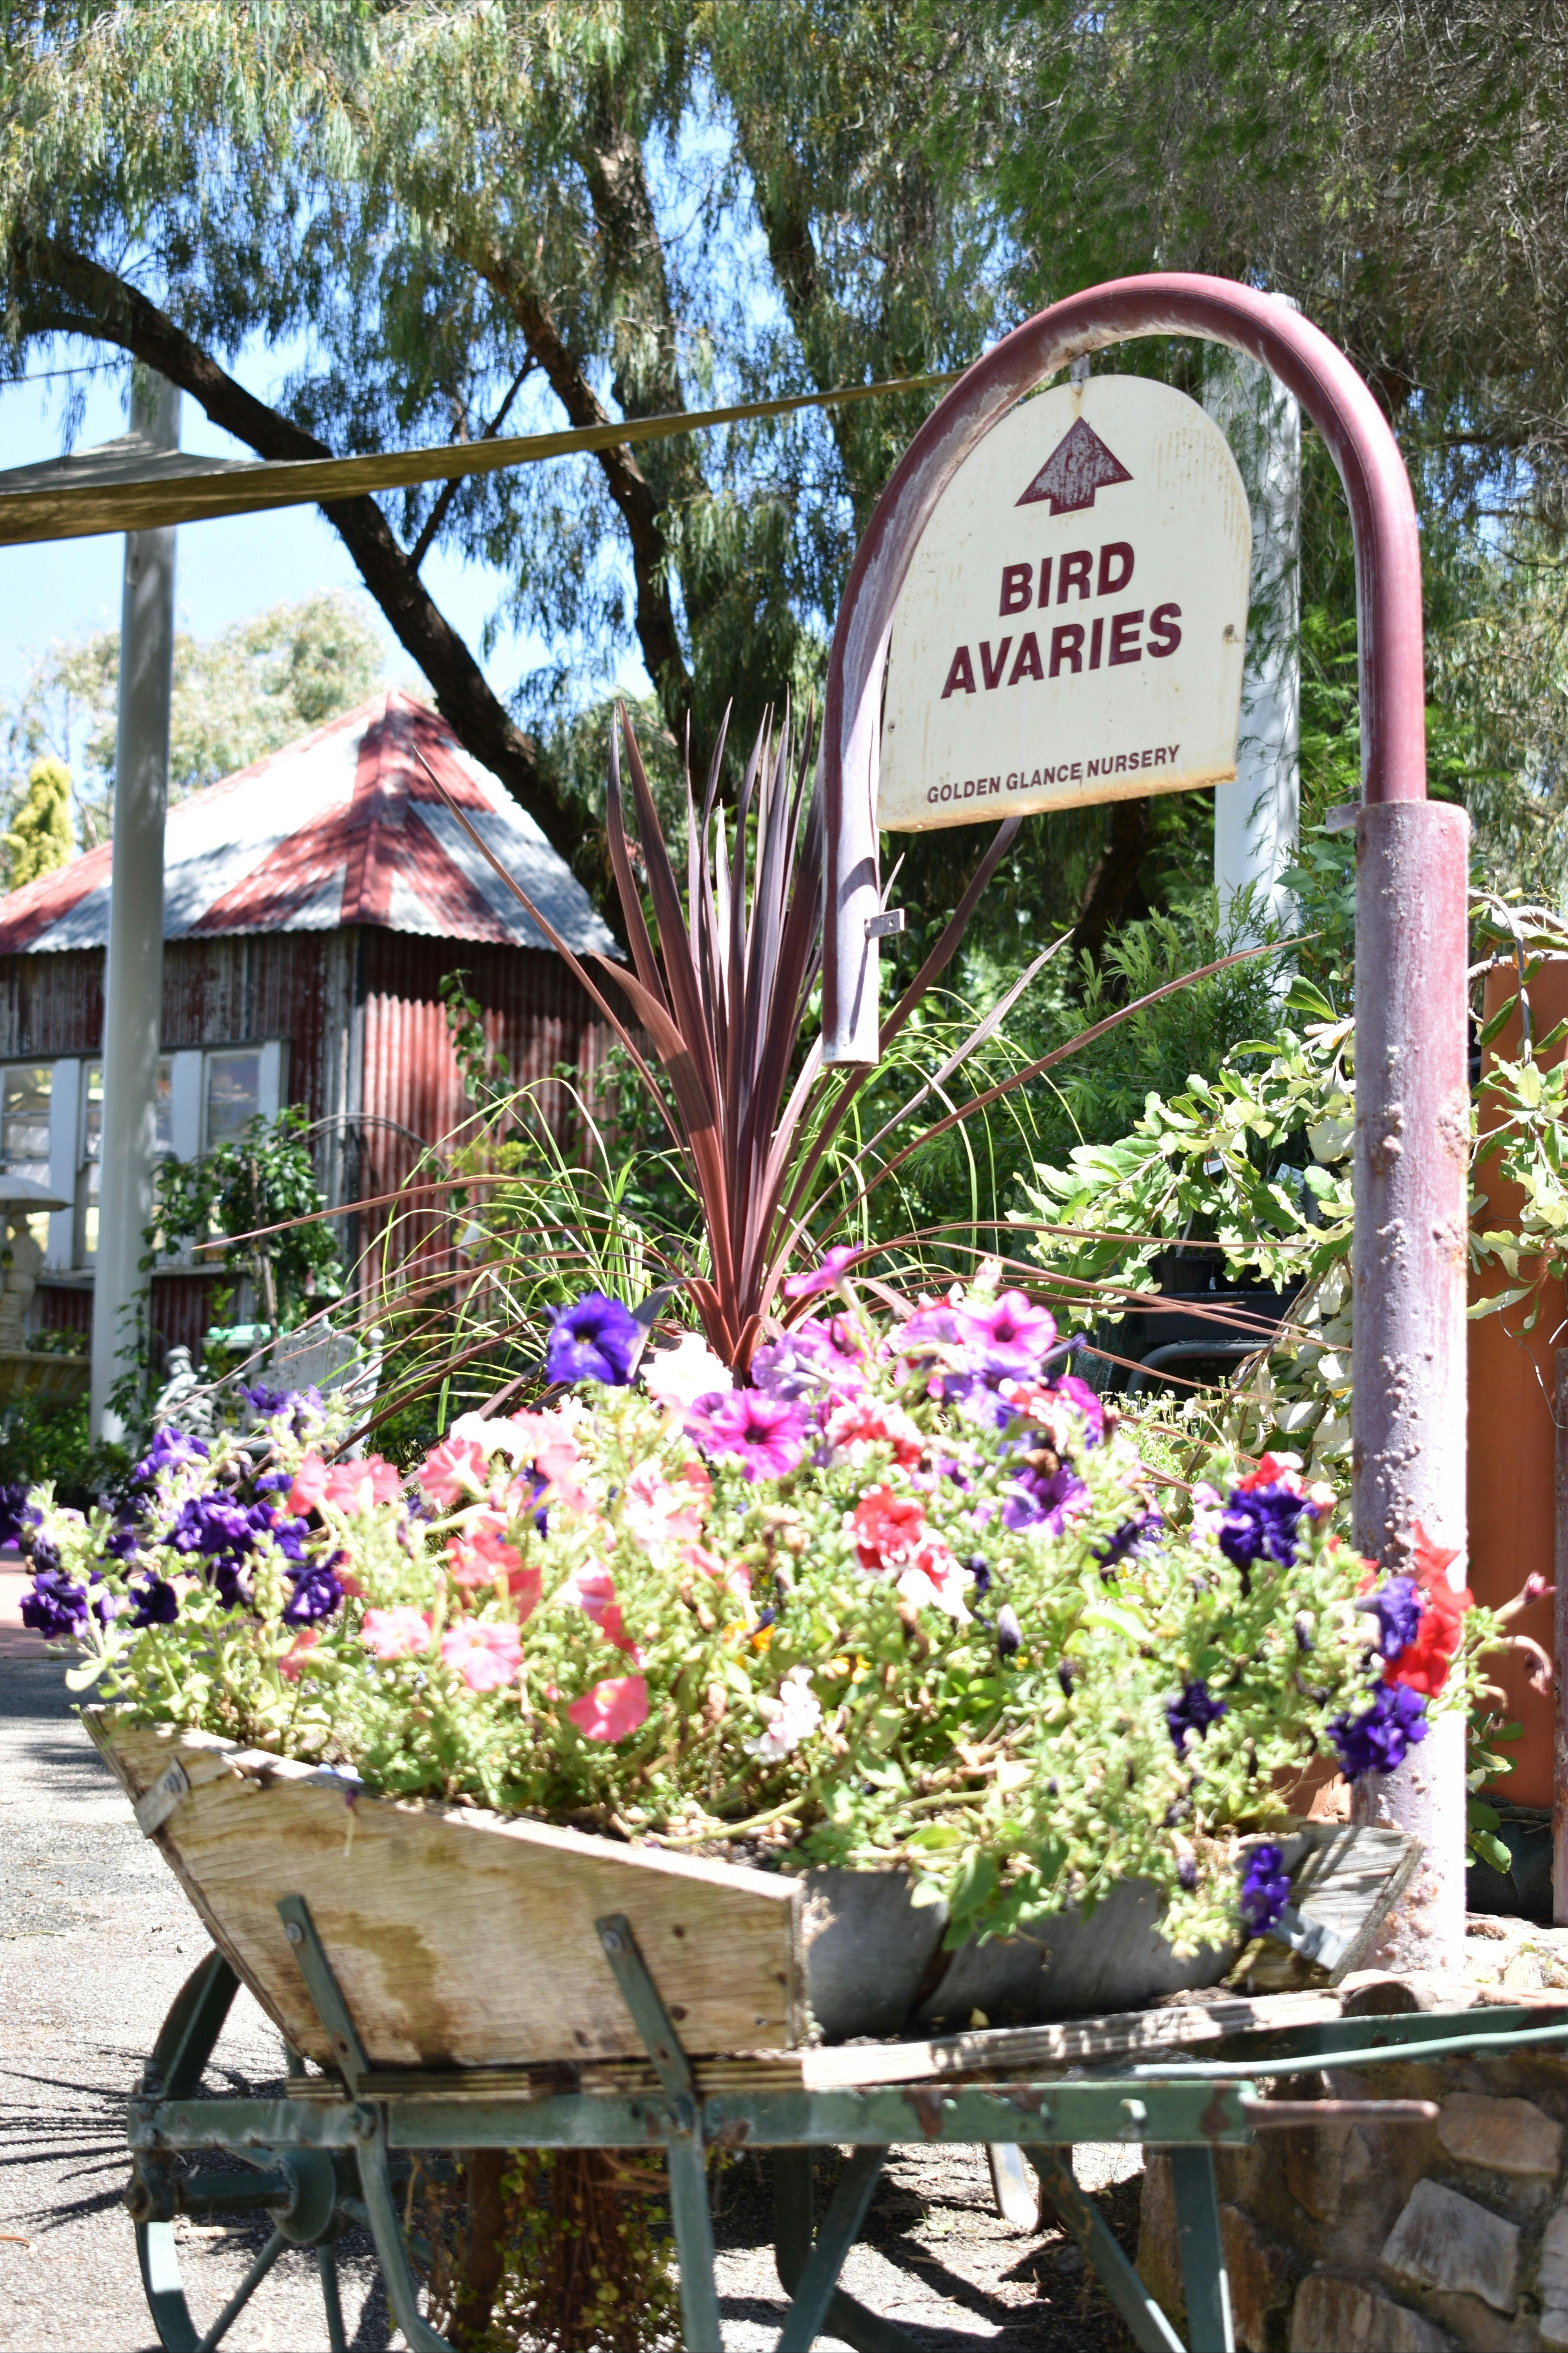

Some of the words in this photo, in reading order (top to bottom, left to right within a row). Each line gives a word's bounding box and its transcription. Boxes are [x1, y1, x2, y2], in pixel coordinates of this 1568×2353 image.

[999, 542, 1135, 617] BIRD
[941, 603, 1182, 699] AVARIES
[927, 777, 1001, 803] GOLDEN
[1006, 763, 1082, 790] GLANCE
[1087, 745, 1180, 777] NURSERY
